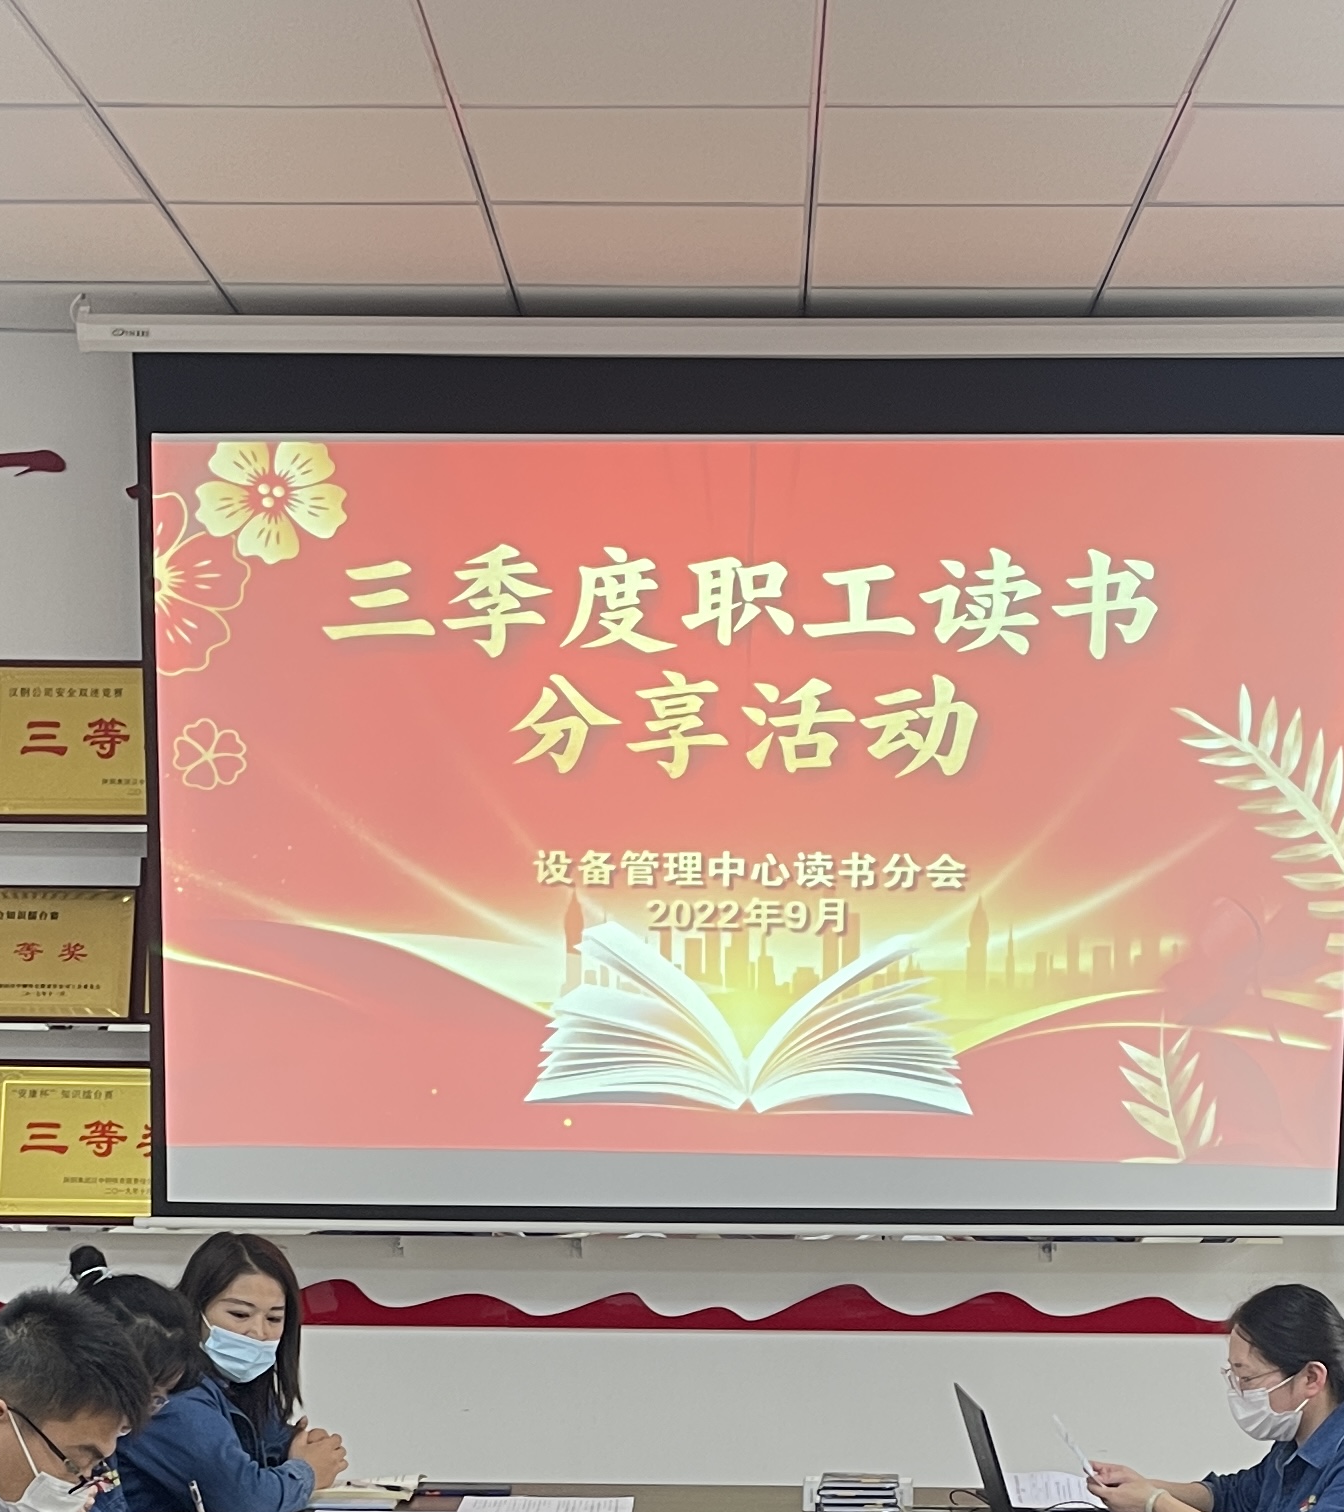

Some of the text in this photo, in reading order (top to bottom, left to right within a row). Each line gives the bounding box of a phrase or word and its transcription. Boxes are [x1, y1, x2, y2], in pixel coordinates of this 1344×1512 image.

[323, 544, 1158, 659] 三季度职工读书
[509, 671, 978, 778] 分享活动
[533, 850, 968, 889] 设备管理中心读书分会
[646, 898, 848, 934] 2022年9月
